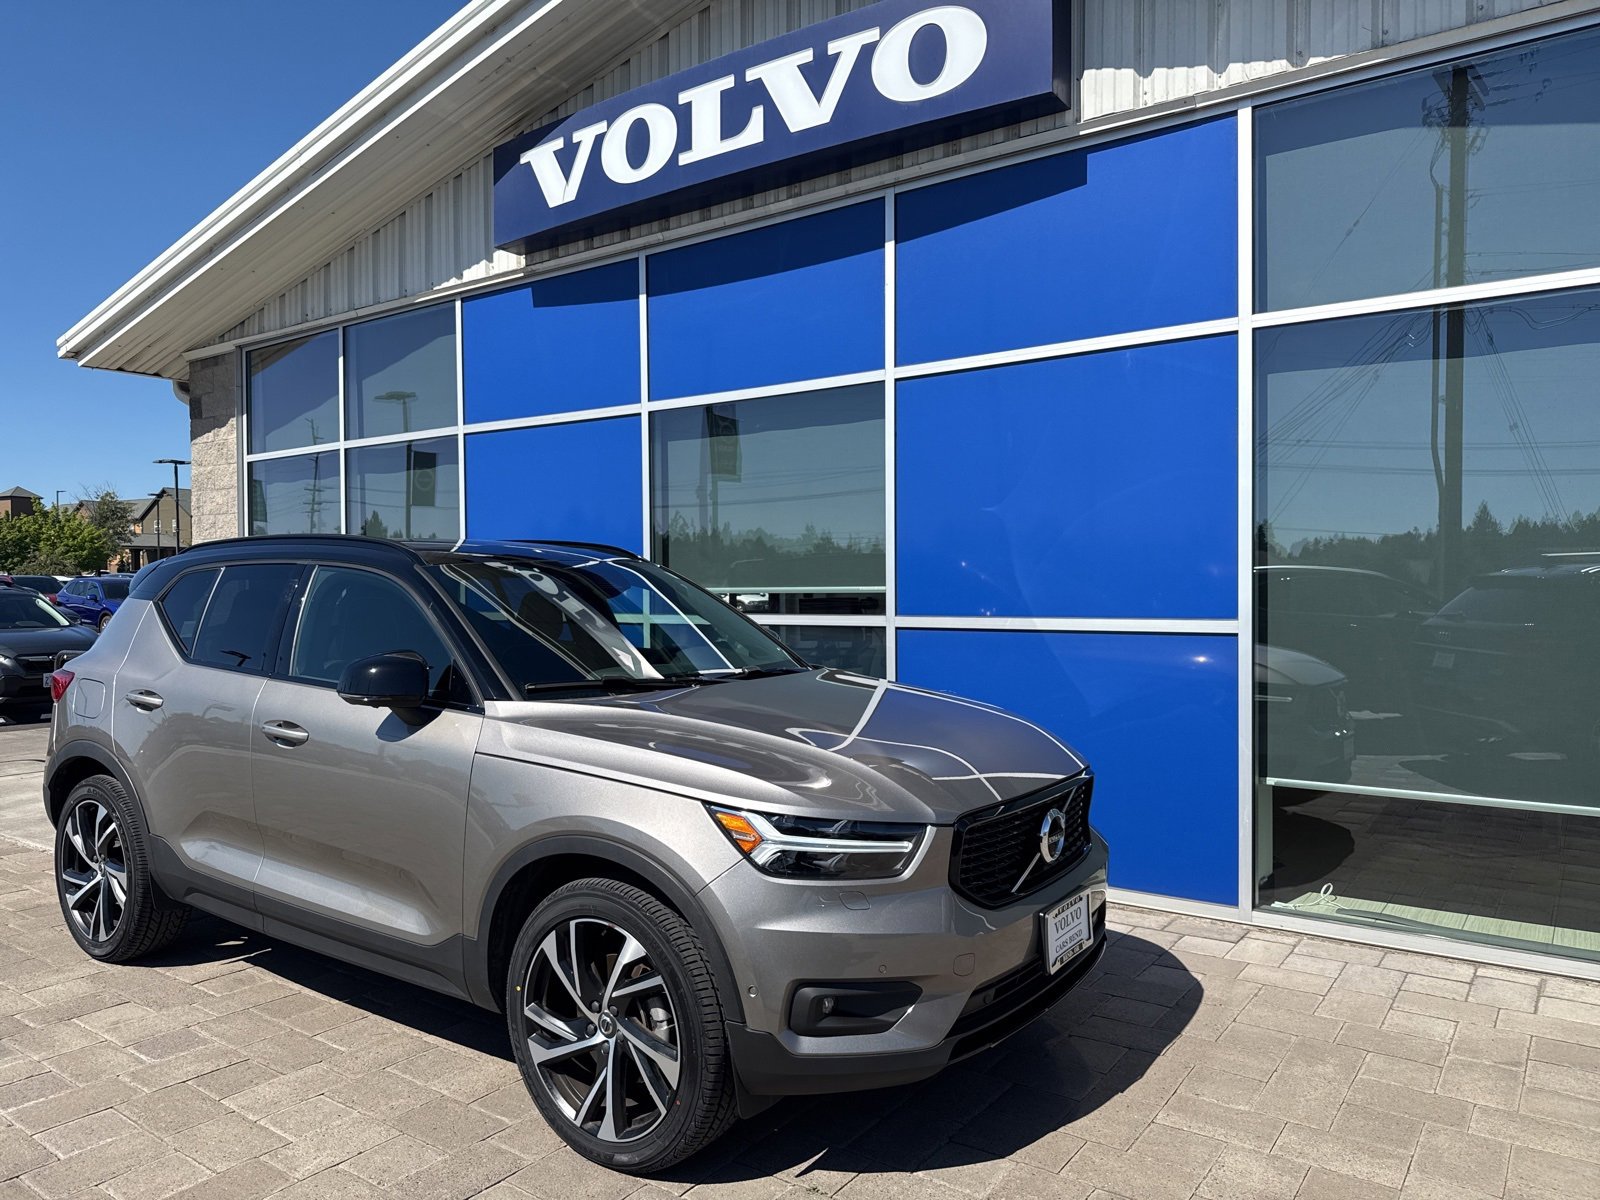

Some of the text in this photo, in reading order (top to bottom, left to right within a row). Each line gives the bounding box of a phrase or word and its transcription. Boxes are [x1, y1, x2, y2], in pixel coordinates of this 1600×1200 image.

[519, 4, 989, 209] VOLVO
[1054, 906, 1082, 934] VOLVO
[1055, 937, 1069, 954] CARS
[1069, 928, 1083, 945] BEND
